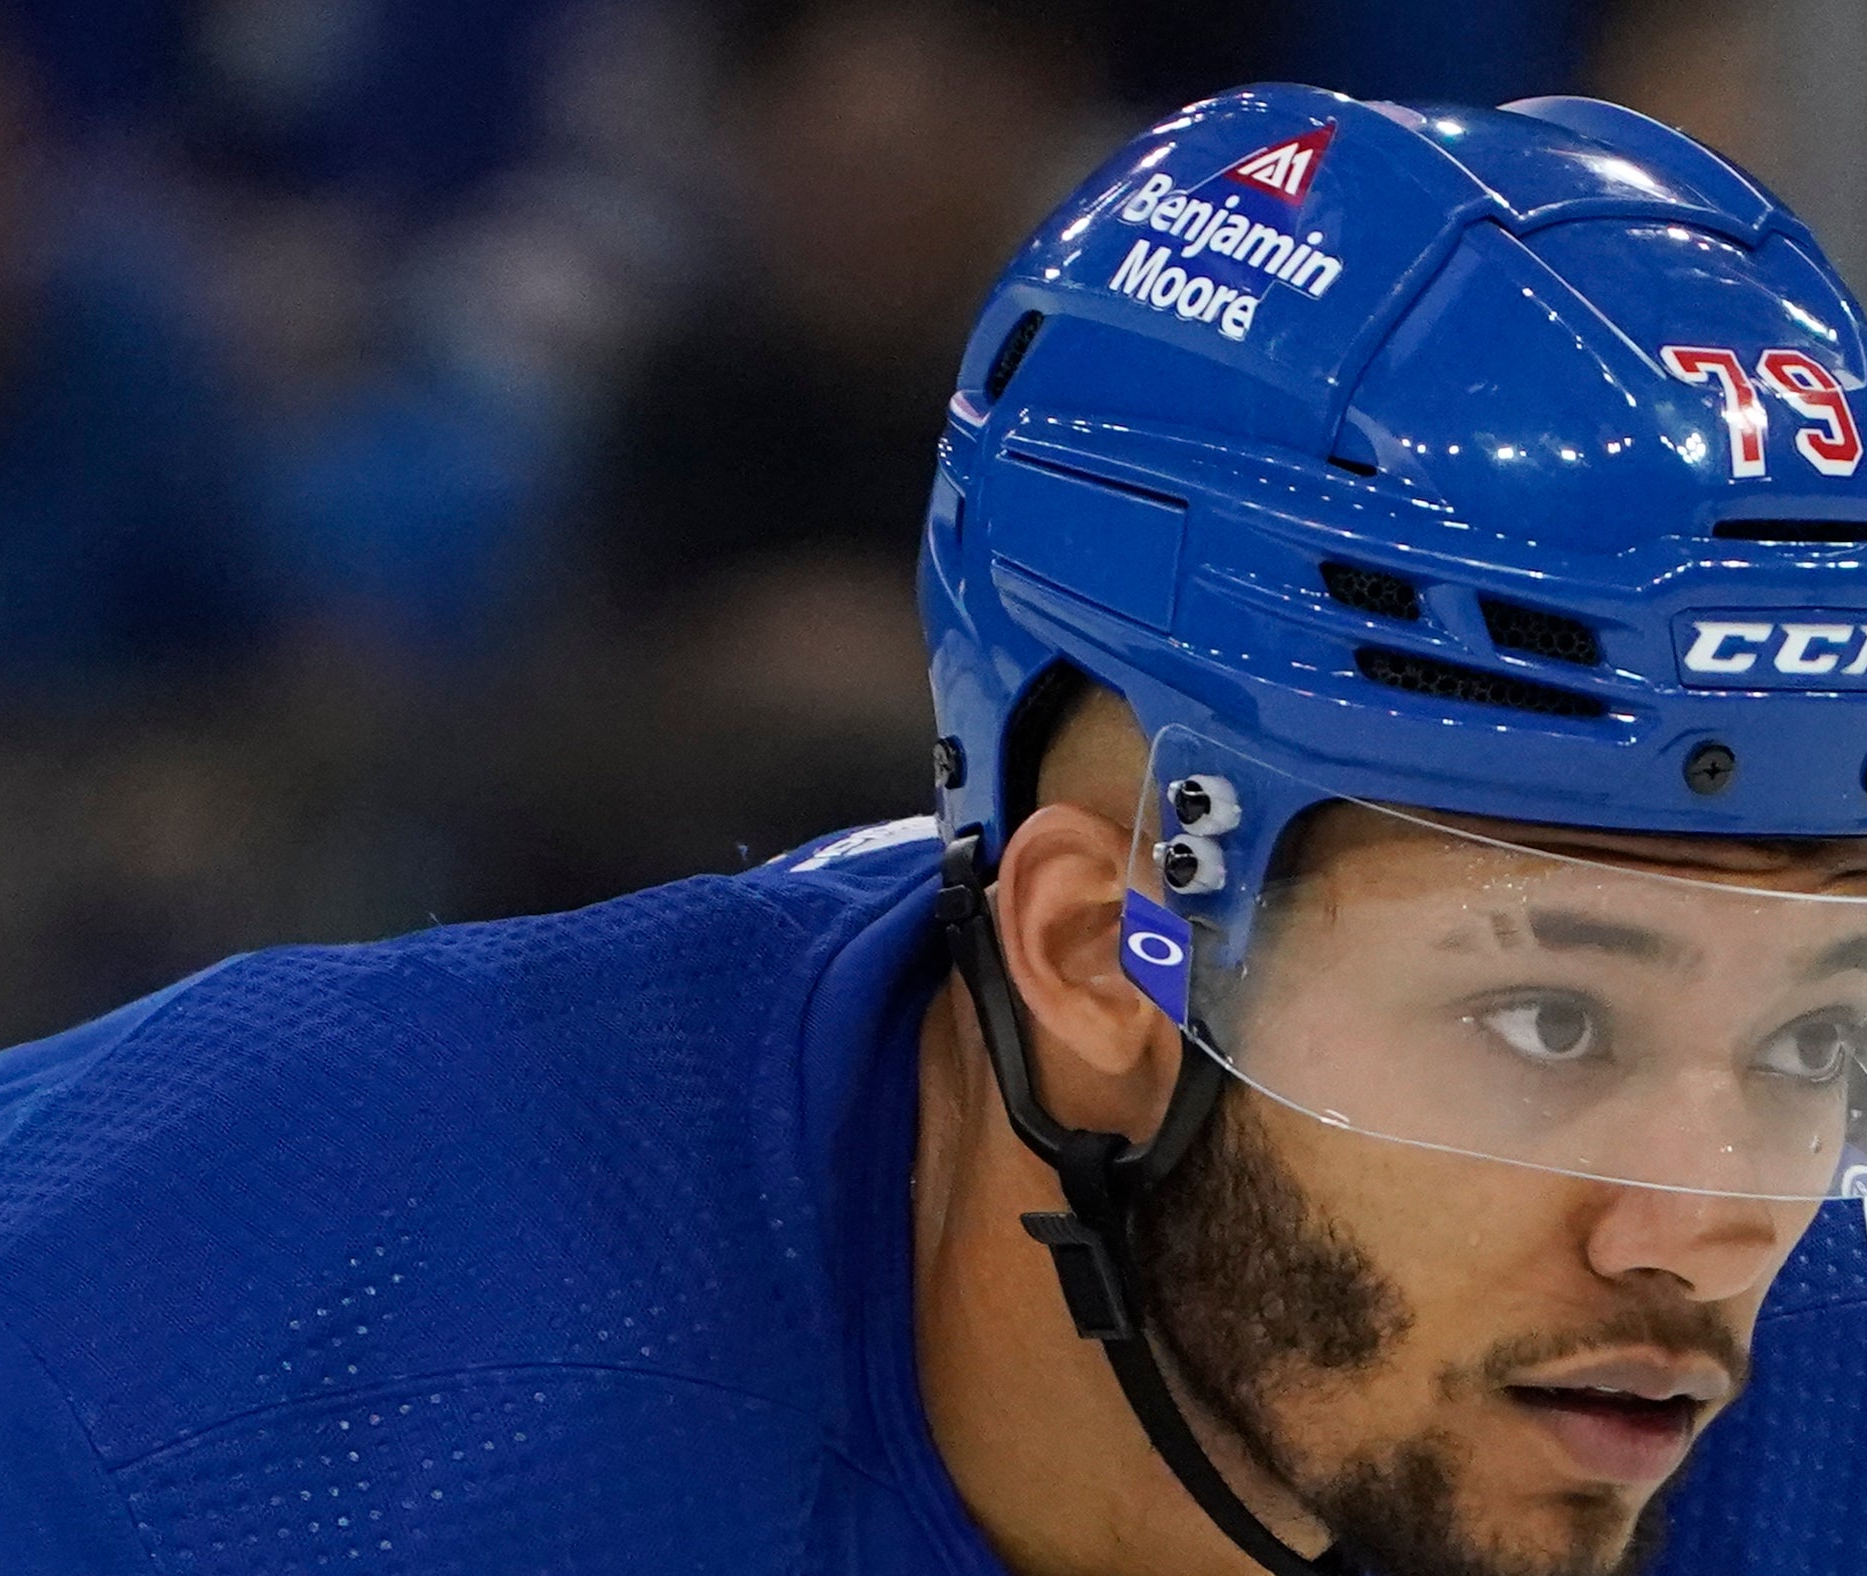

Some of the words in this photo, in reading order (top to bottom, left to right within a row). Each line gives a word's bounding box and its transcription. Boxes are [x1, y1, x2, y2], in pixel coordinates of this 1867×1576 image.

[1108, 239, 1262, 341] Moore
[1122, 172, 1343, 297] Benjamin
[1660, 345, 1864, 477] 79
